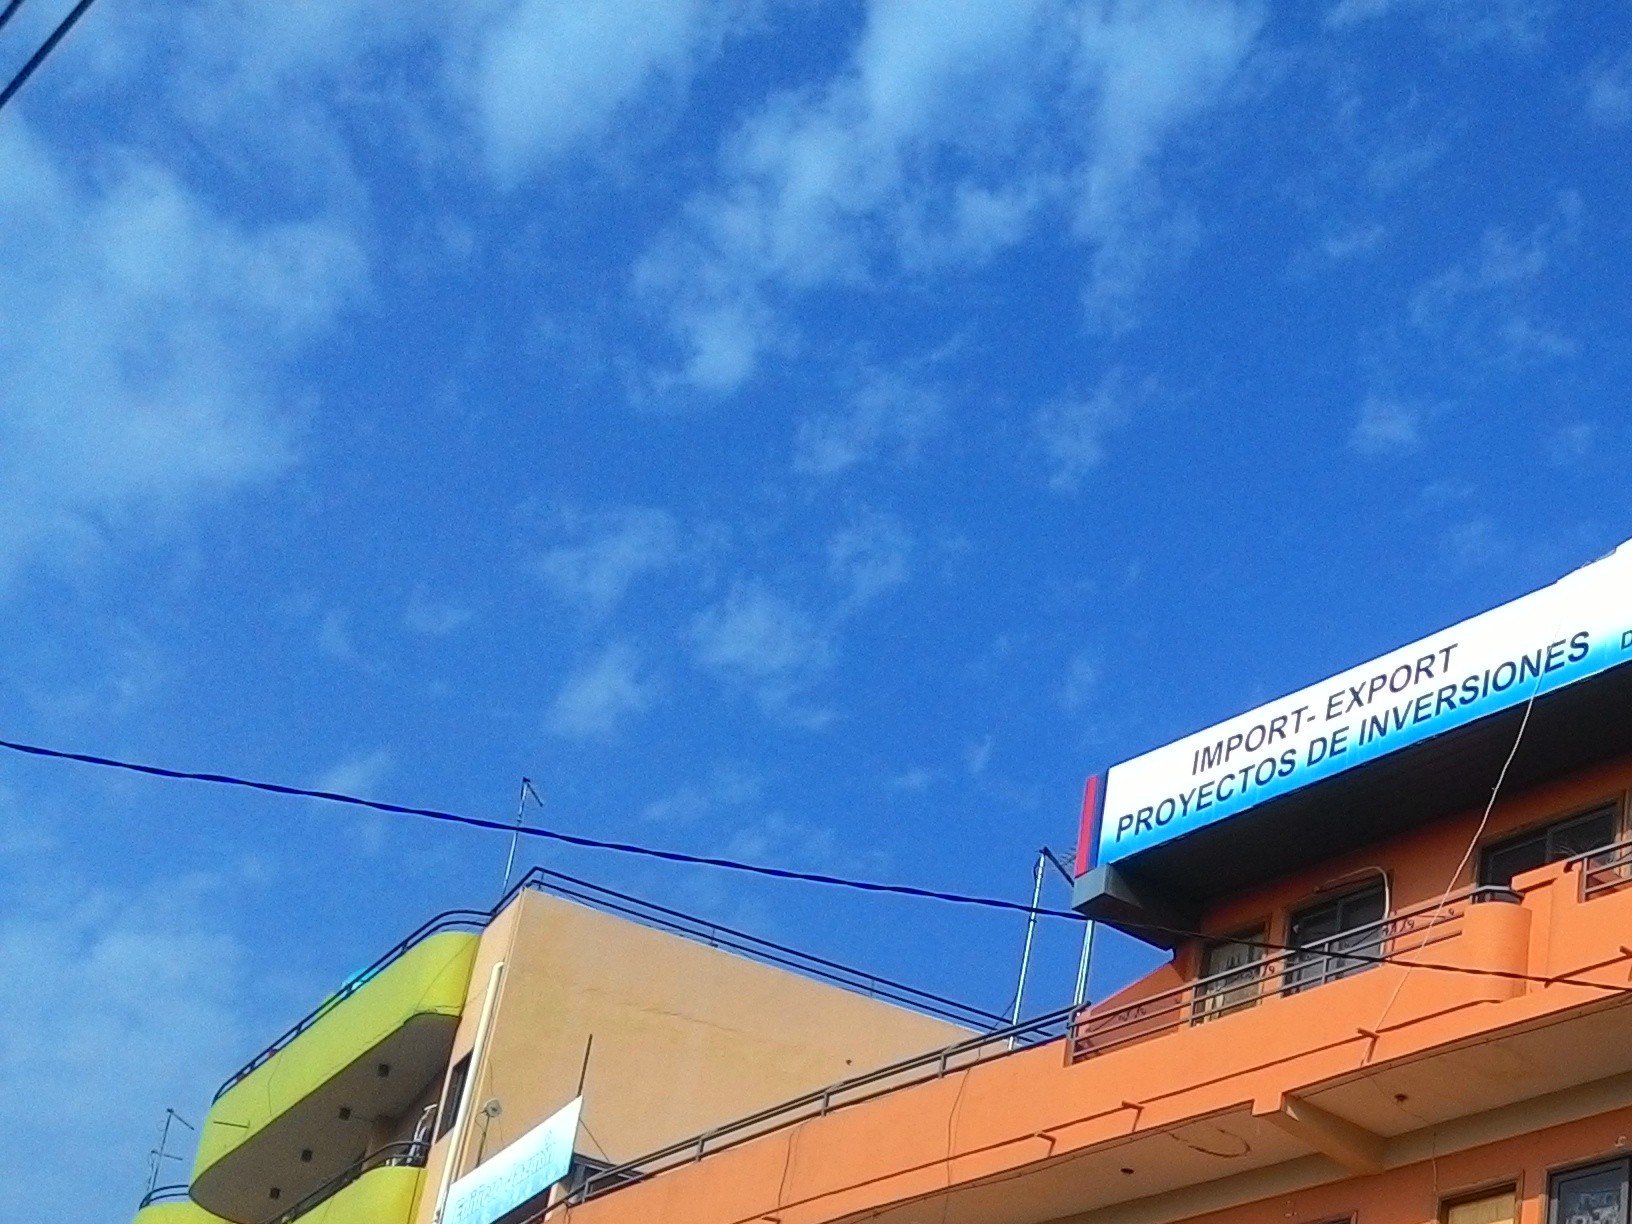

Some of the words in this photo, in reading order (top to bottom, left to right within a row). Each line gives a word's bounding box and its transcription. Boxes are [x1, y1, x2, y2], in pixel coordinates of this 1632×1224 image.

[1115, 748, 1297, 843] PROYECTOS
[1306, 726, 1350, 768] DE
[1358, 630, 1591, 746] INVERSIONES
[1324, 643, 1459, 721] EXPORT
